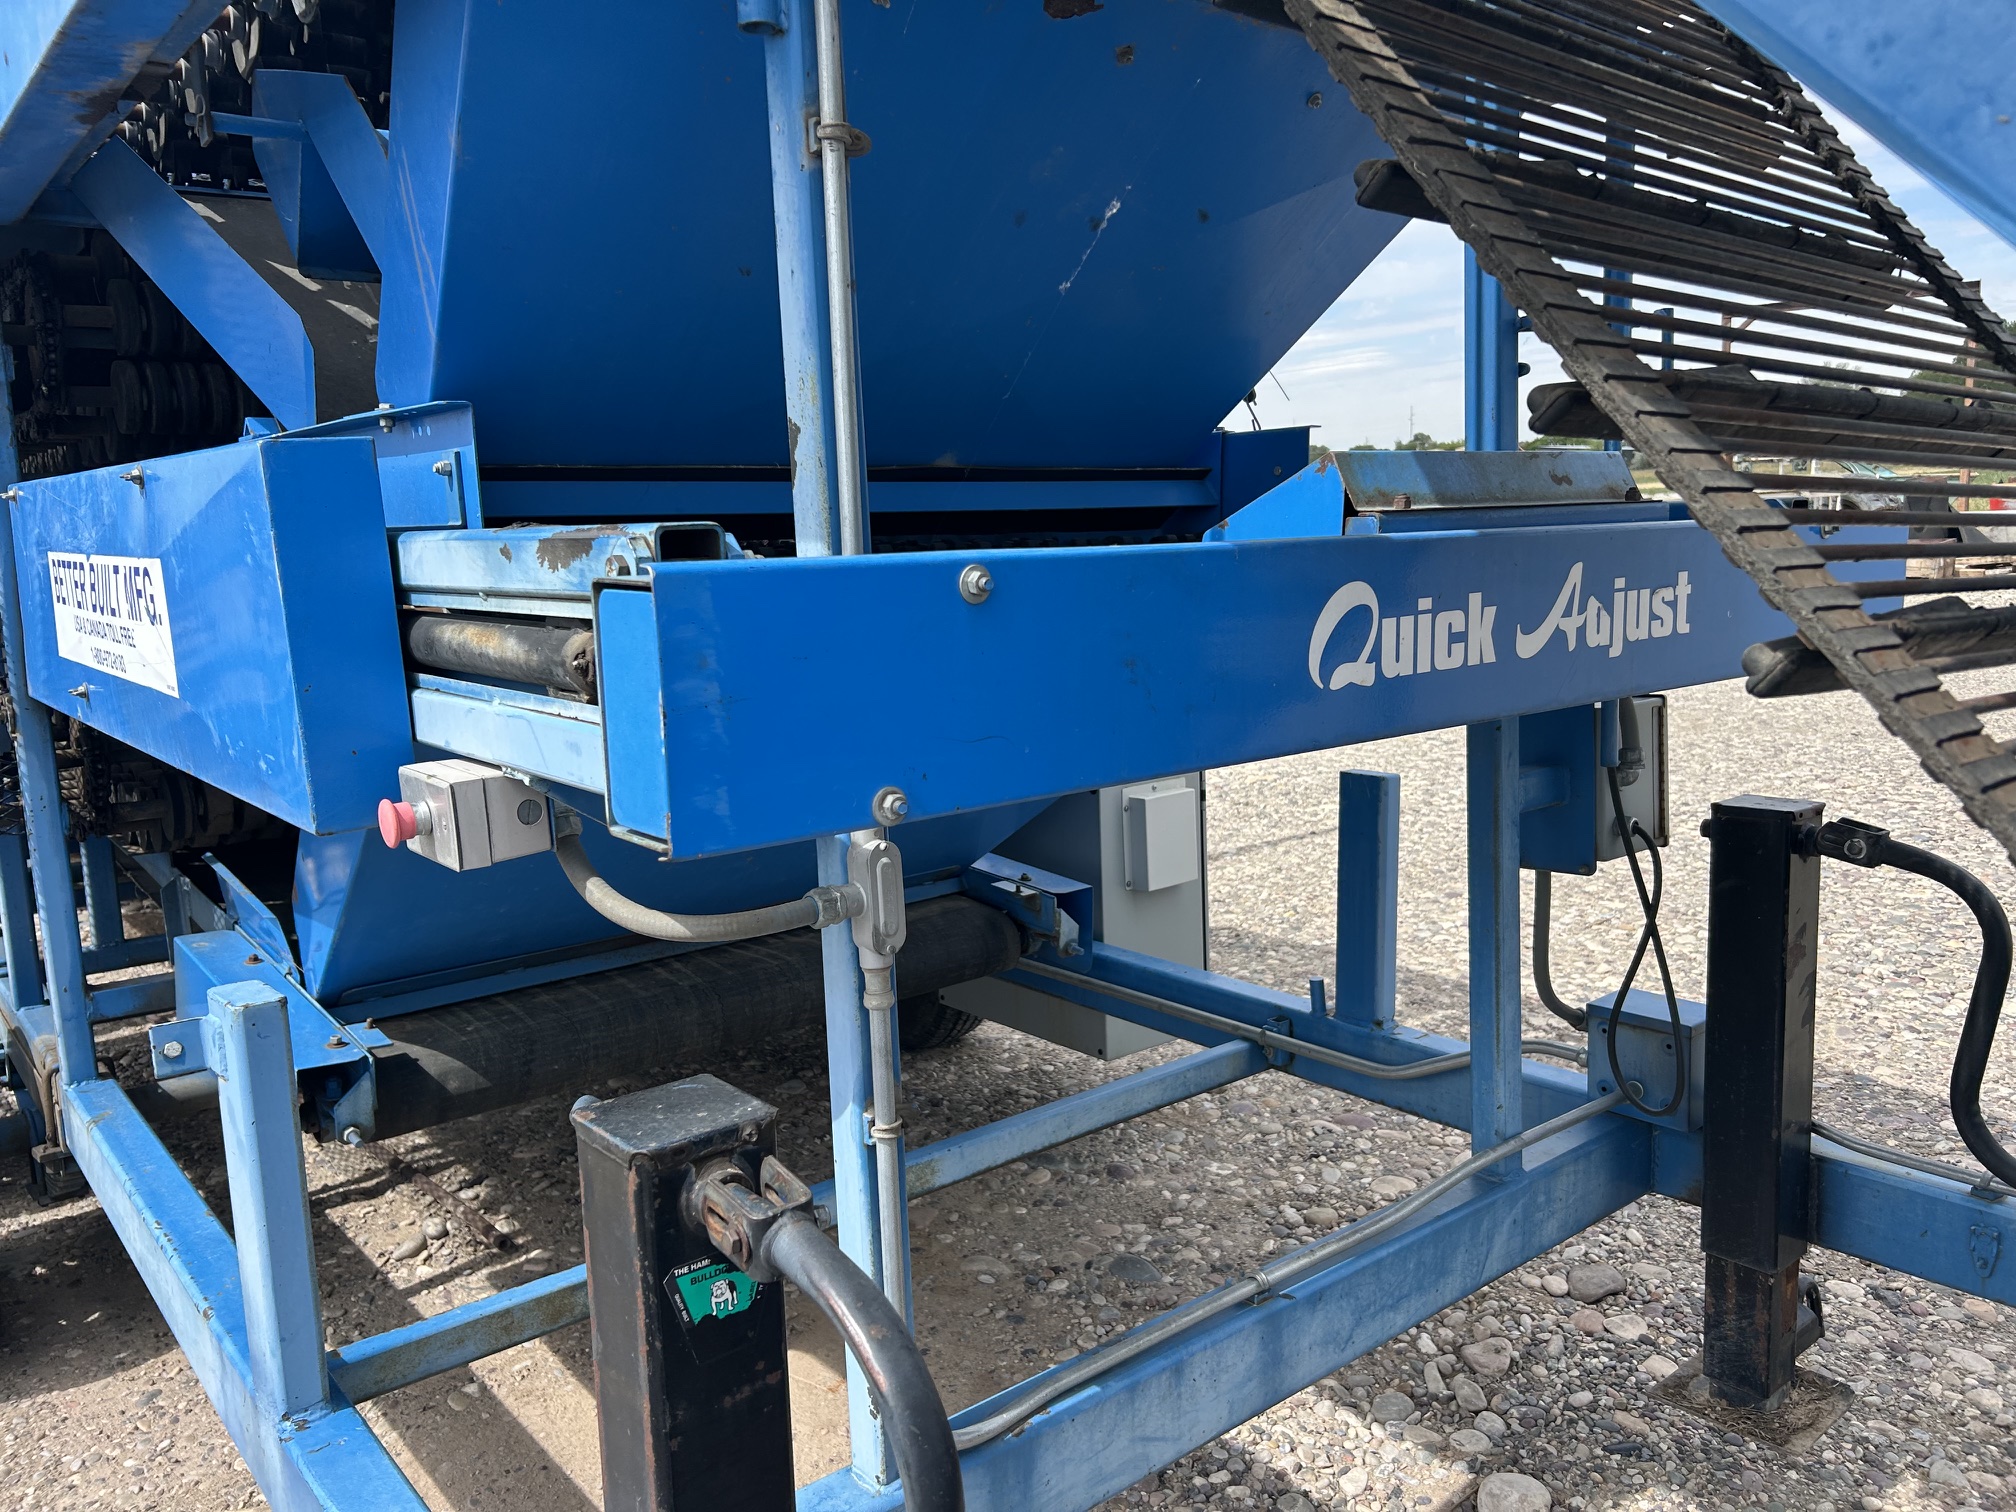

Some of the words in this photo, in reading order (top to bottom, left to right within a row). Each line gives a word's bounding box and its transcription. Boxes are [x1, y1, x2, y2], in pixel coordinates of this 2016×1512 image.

[52, 559, 89, 611] BETTER
[89, 562, 122, 619] BUILT
[123, 565, 163, 627] MFG.
[1308, 577, 1497, 691] Quick
[1515, 561, 1692, 659] Adjust
[674, 1265, 689, 1277] THE
